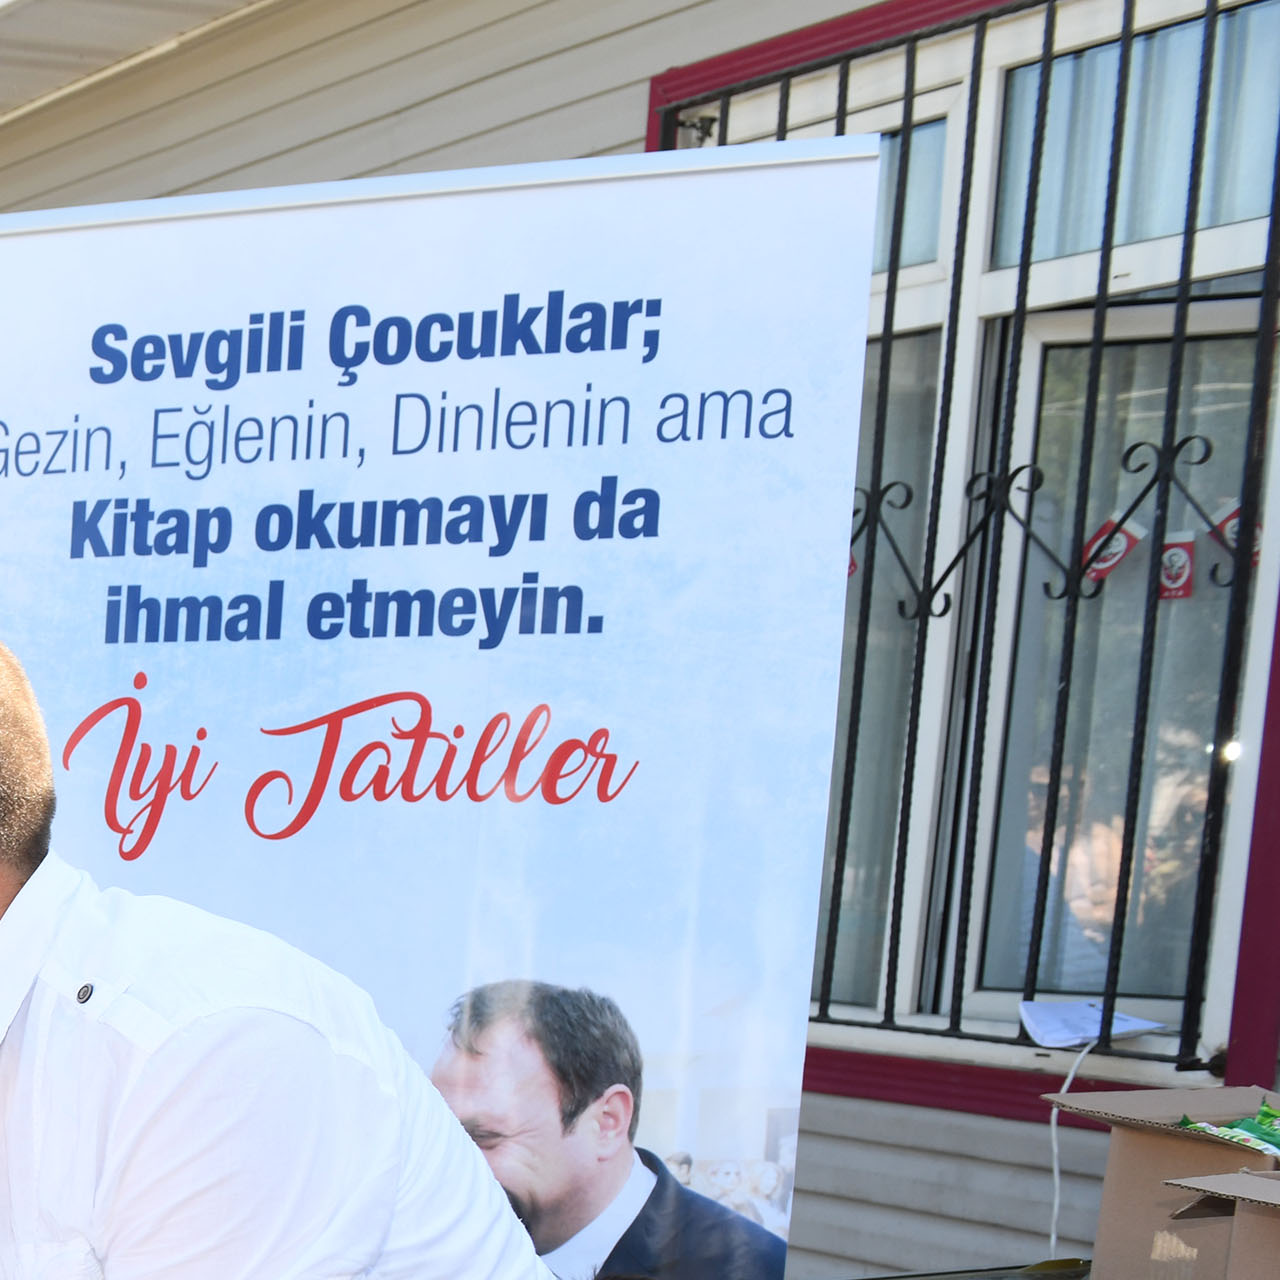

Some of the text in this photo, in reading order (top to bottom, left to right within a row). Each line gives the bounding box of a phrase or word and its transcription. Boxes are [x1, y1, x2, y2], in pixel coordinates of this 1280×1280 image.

[89, 289, 662, 391] Sevgili Çocuklar;
[150, 398, 366, 481] Eğlenin,
[392, 382, 631, 456] Dinlenin
[655, 387, 795, 444] ama
[70, 475, 662, 569] Kitap okumayı da
[104, 571, 605, 650] ihmal etmeyin.
[62, 671, 639, 861] İyi Tatiller
